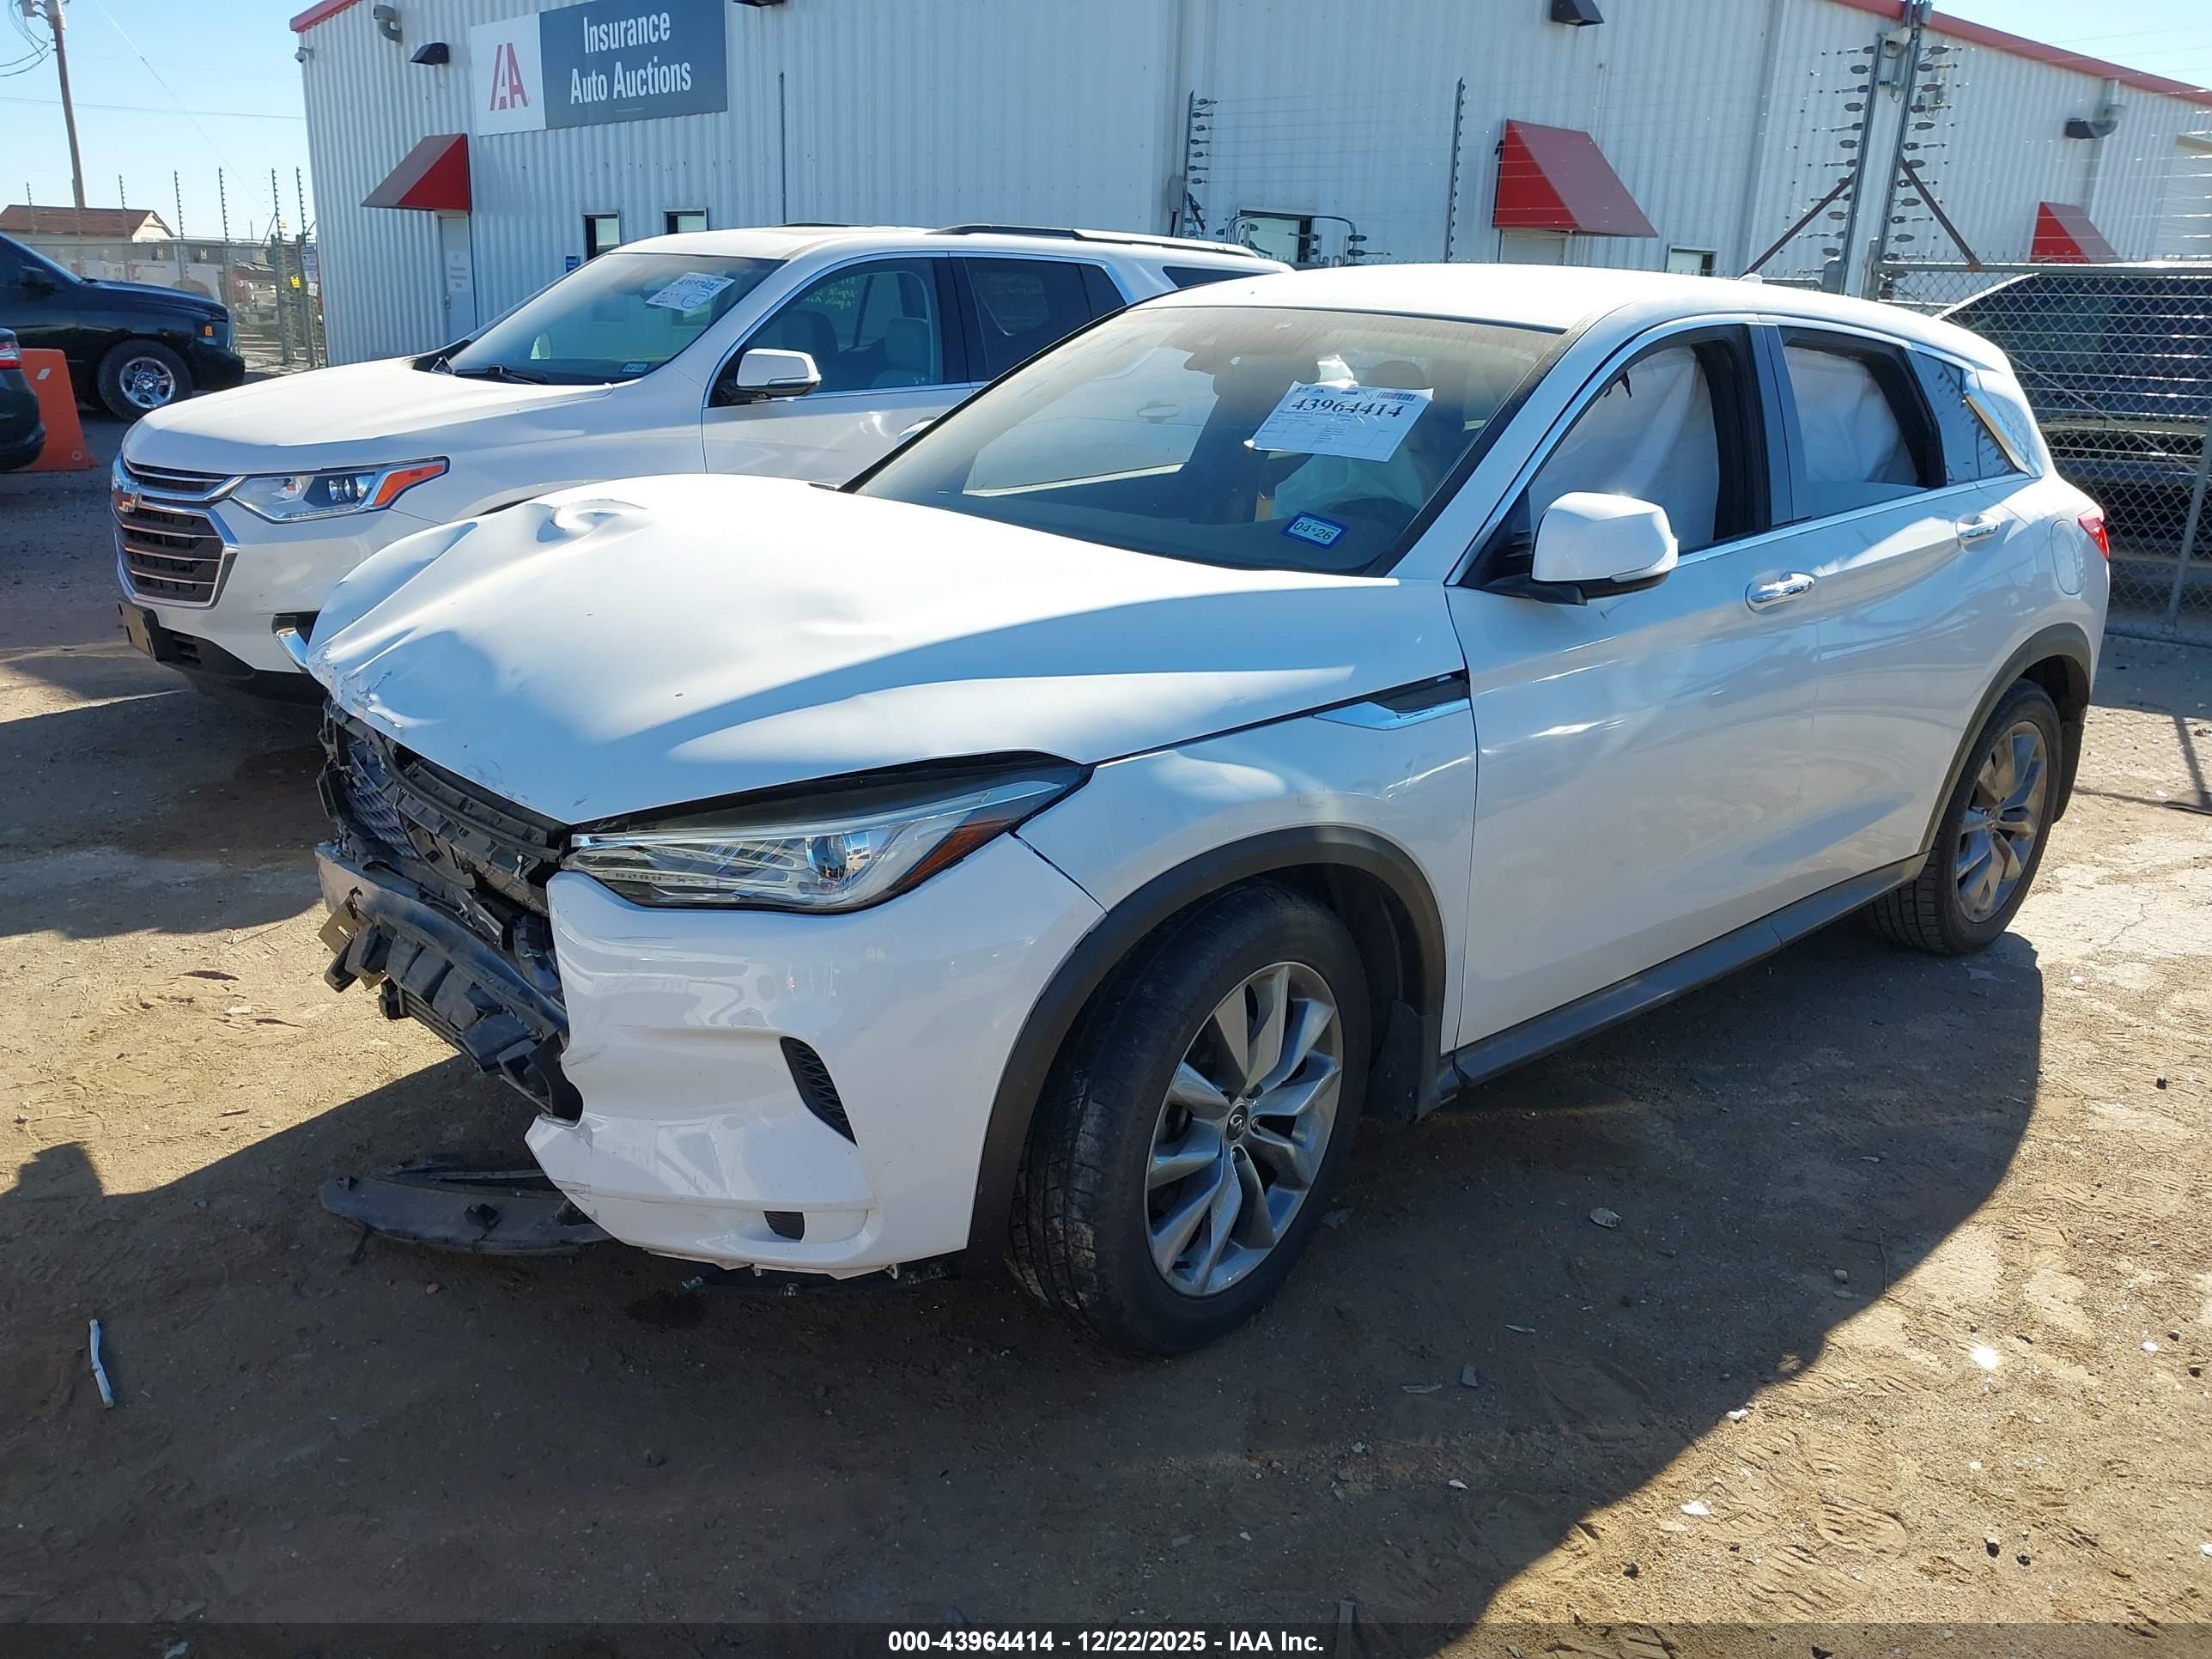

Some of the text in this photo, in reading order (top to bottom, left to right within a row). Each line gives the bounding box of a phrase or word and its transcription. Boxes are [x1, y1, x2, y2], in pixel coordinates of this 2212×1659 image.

[583, 12, 671, 53] Insurance
[570, 55, 692, 105] Auto Auctions
[1291, 398, 1405, 417] 43964414
